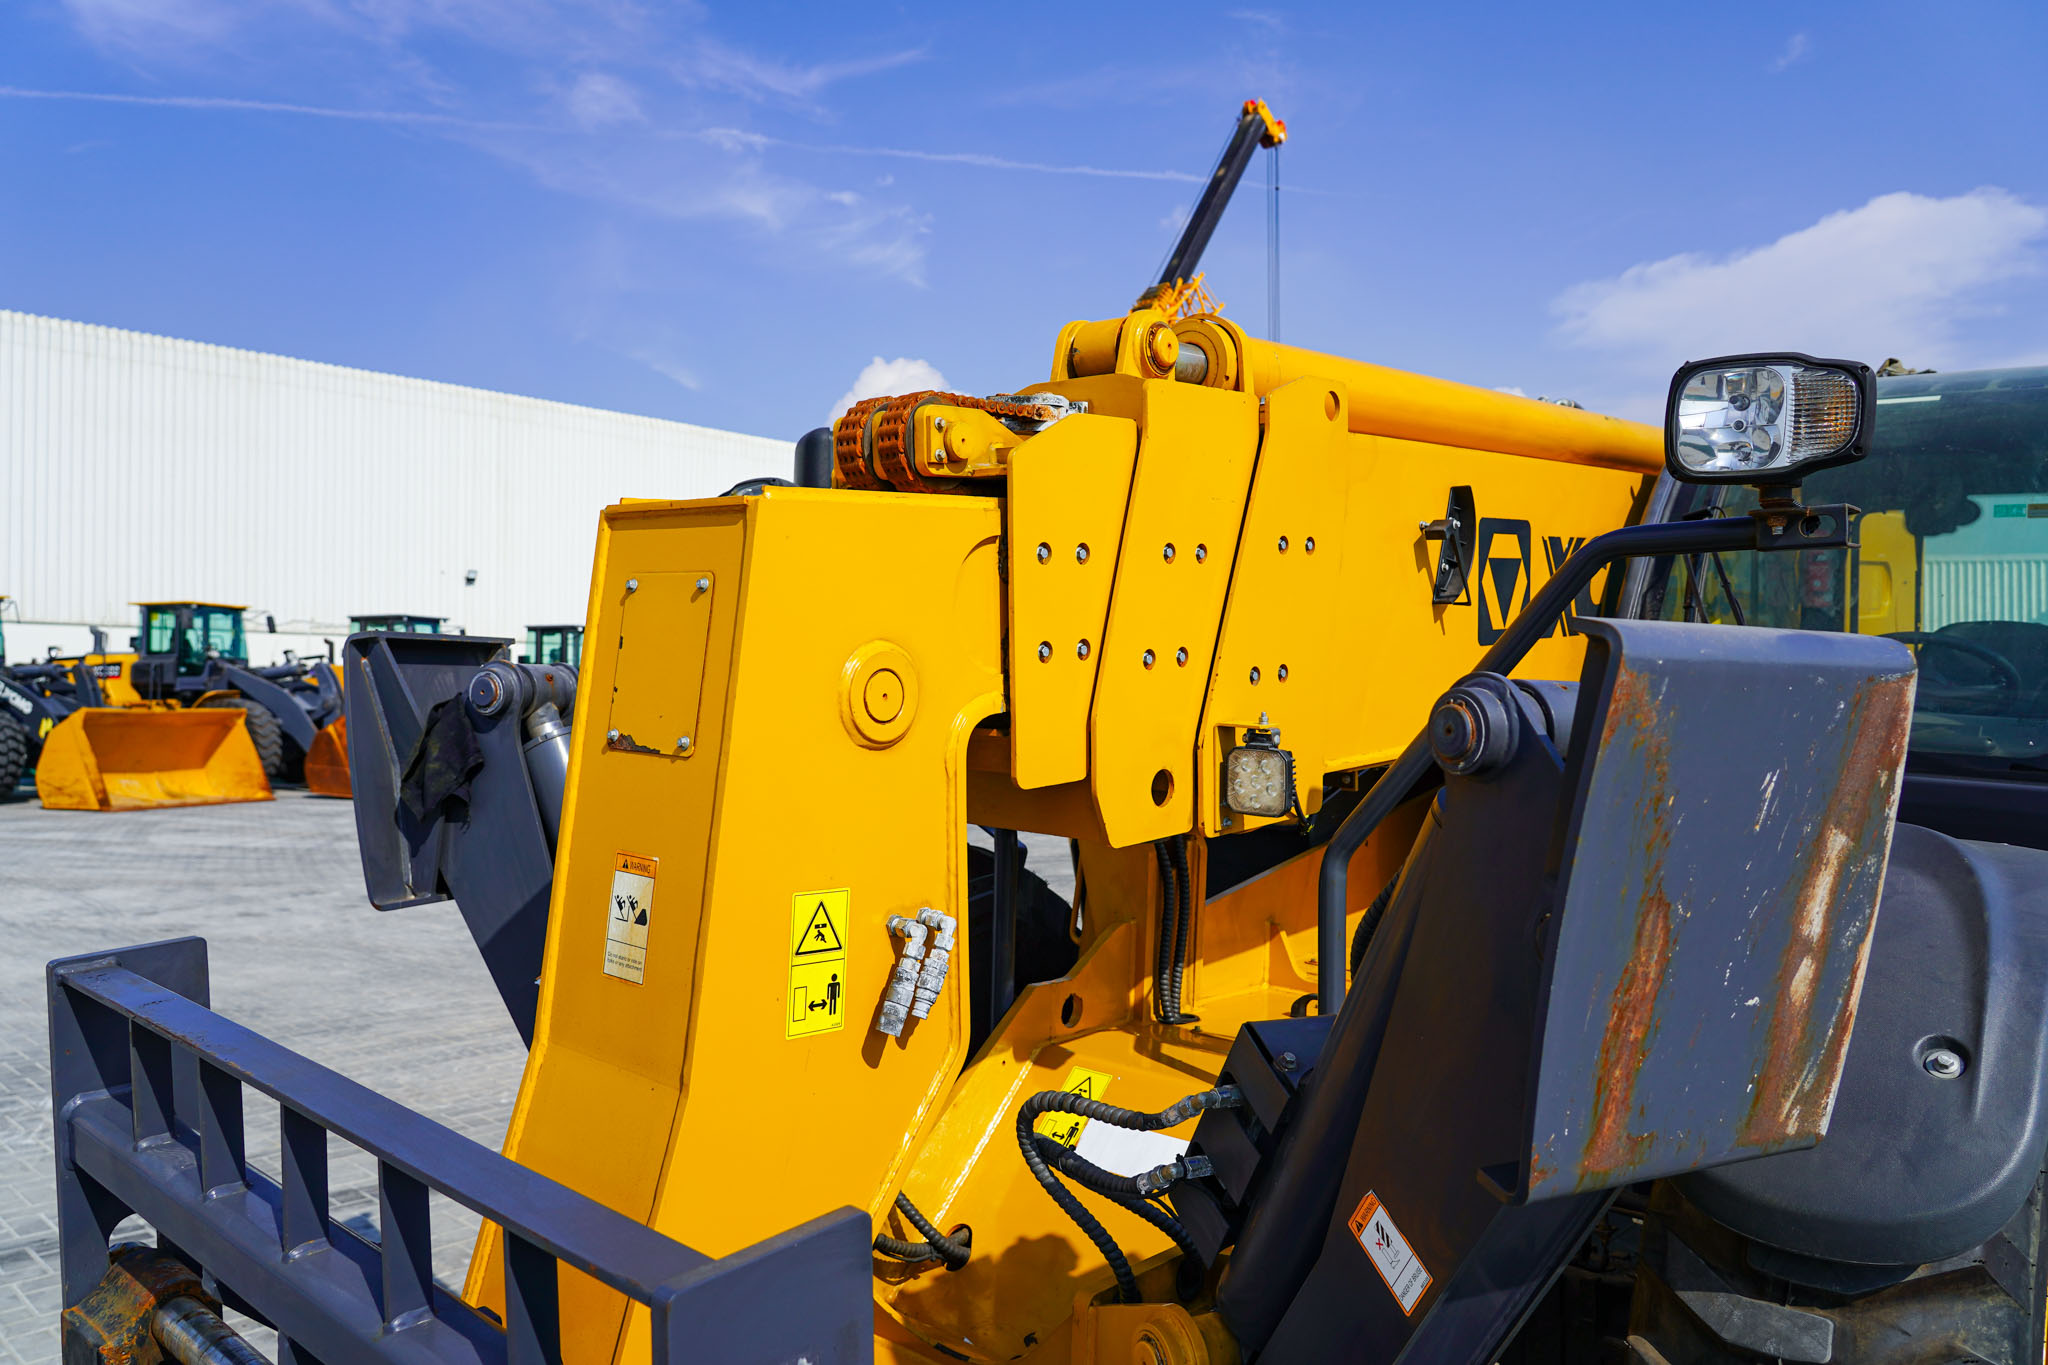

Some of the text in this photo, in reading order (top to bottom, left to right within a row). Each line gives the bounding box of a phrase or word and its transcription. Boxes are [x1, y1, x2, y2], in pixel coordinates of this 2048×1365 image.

[630, 861, 651, 874] WARNING
[1360, 1197, 1377, 1223] WARNING
[1399, 1283, 1411, 1301] DANGER
[1408, 1277, 1414, 1287] OF
